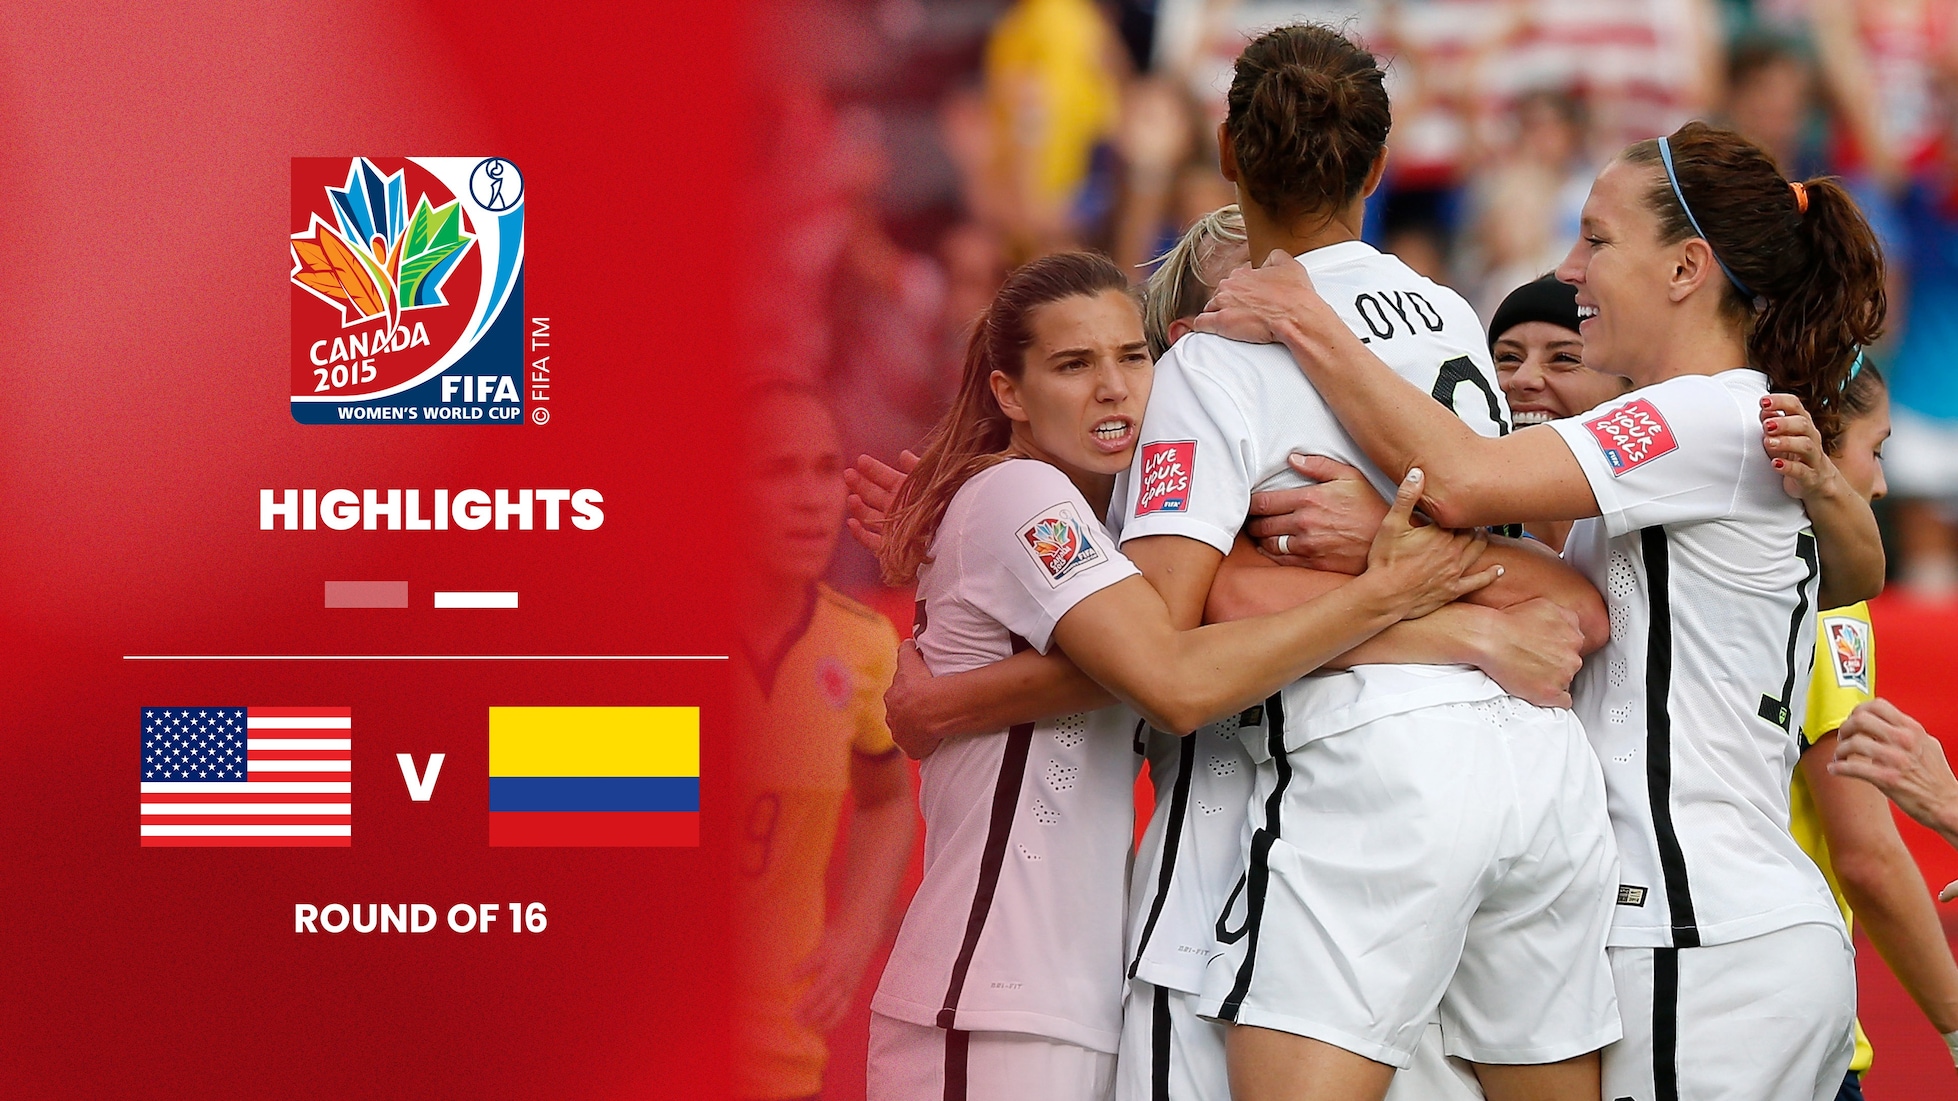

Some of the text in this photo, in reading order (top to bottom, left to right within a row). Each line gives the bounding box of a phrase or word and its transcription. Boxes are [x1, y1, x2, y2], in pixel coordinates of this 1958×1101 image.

[1355, 291, 1443, 344] OYD
[1611, 411, 1653, 453] YOUR
[1625, 405, 1662, 436] LIVE
[1596, 421, 1645, 462] GOALS
[1144, 462, 1186, 491] YOUR
[1145, 448, 1177, 474] LIVE
[1141, 476, 1188, 508] GOALS
